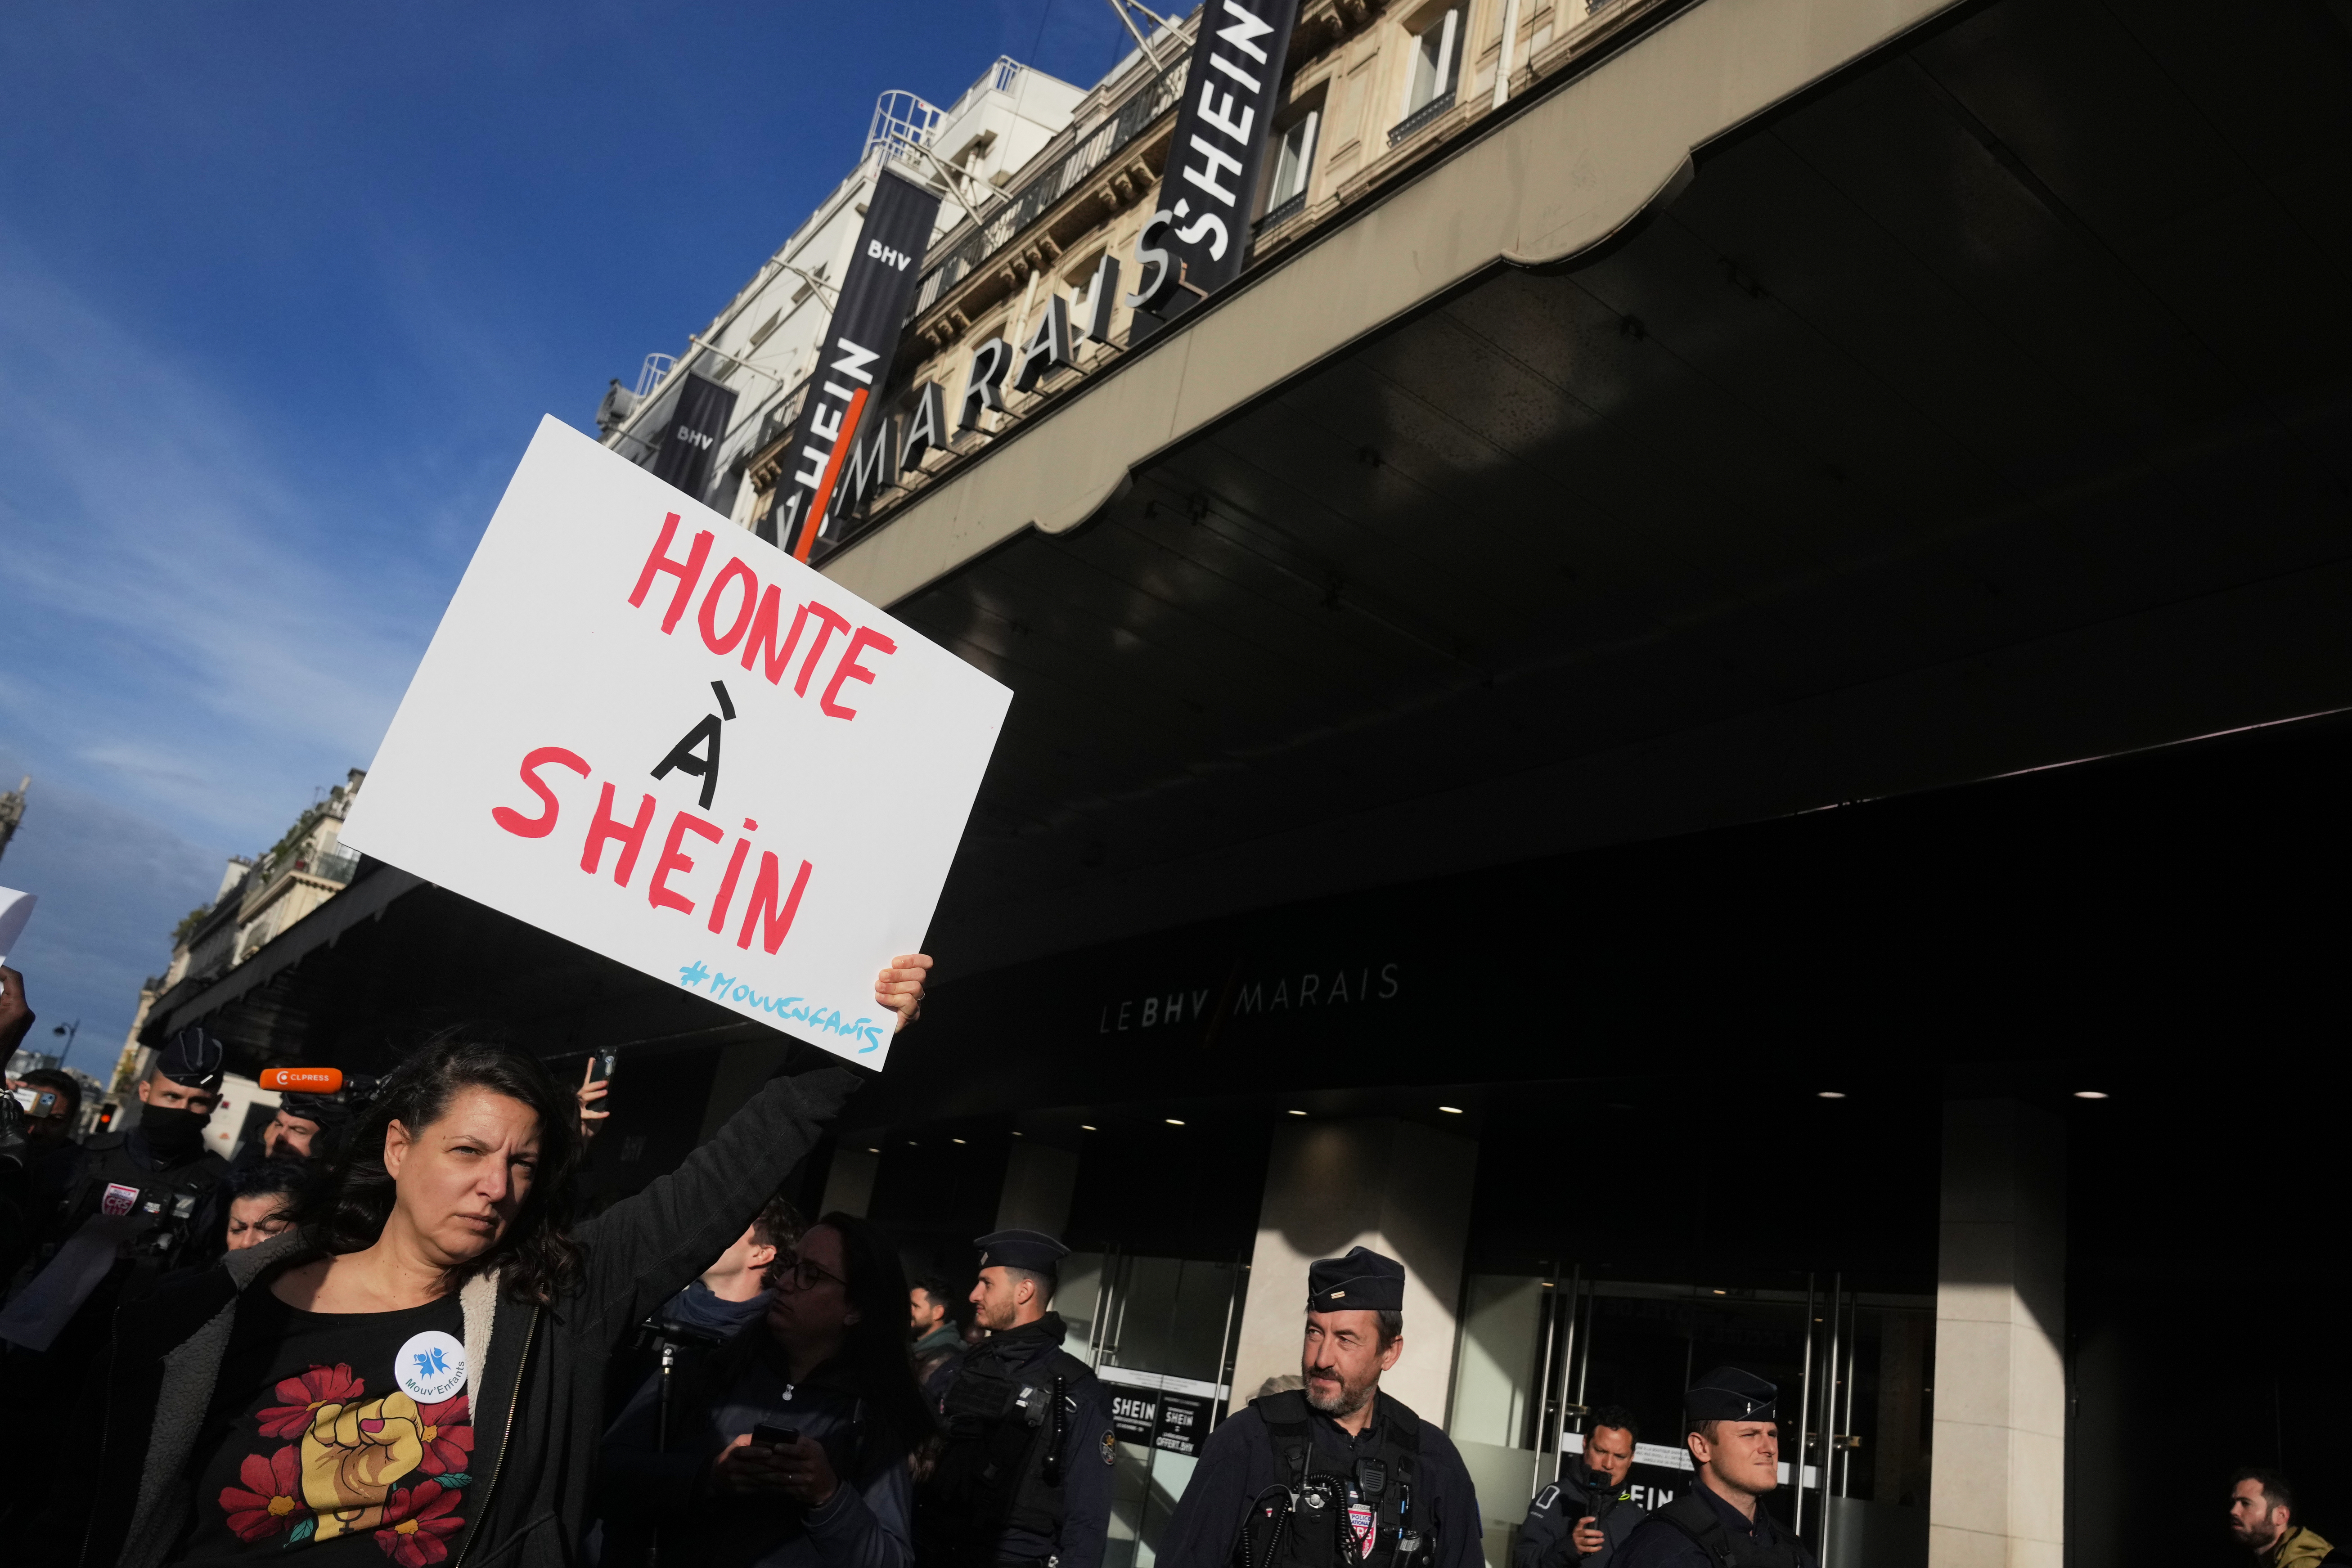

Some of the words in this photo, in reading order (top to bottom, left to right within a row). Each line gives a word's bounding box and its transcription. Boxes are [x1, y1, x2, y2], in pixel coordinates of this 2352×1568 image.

[1174, 0, 1275, 261] SHEIN
[868, 239, 912, 271] BHV
[835, 210, 1173, 517] MARAIS
[677, 426, 713, 450] BHV
[628, 512, 898, 721] HONTE
[650, 680, 737, 810] À
[1141, 989, 1208, 1028] BHV
[1234, 963, 1398, 1015] MARAIS
[107, 1197, 130, 1209] CRS
[405, 1361, 465, 1396] Mouv'Enfants
[1112, 1397, 1156, 1420] SHEIN
[1165, 1411, 1194, 1426] SHEIN
[1621, 1485, 1674, 1511] EIN
